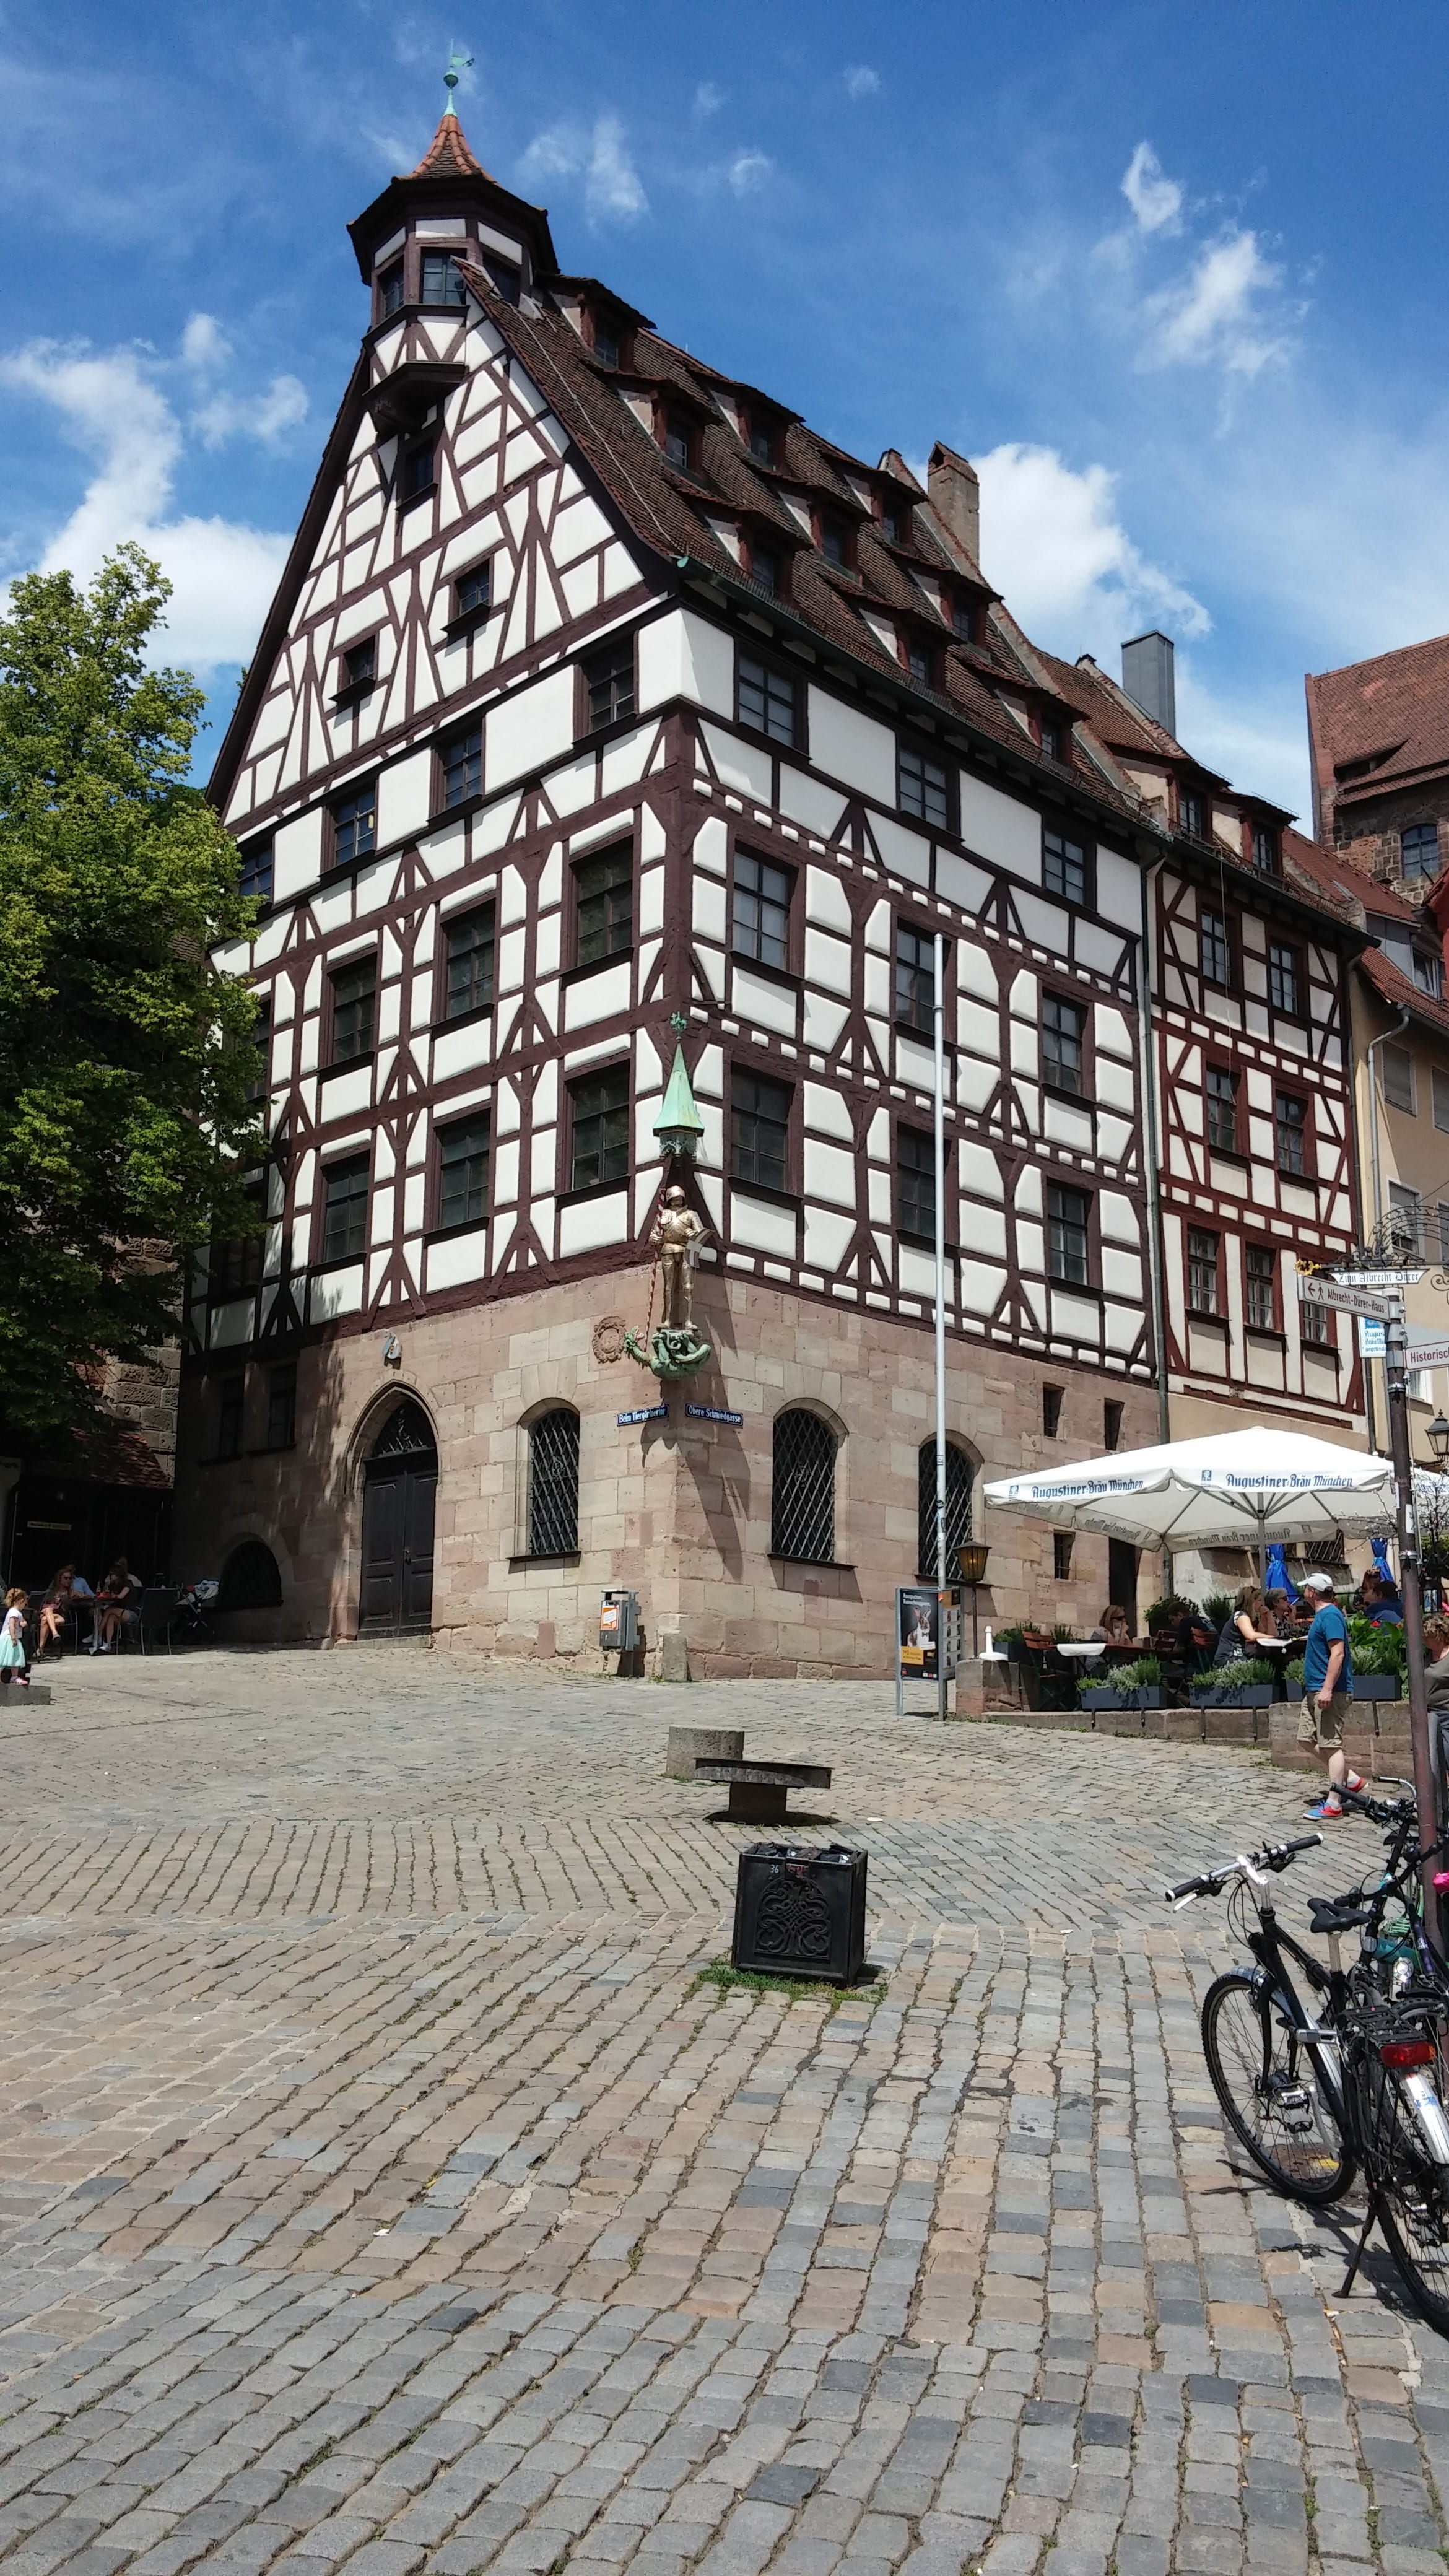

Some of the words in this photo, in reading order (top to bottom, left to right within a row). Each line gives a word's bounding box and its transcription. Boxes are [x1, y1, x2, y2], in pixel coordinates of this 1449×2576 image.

[1359, 1272, 1393, 1283] Albrecht
[1395, 1271, 1420, 1282] Dürer
[1327, 1288, 1385, 1313] Albrecht-Dürer-Haus
[1410, 1347, 1449, 1364] Historisc
[619, 1414, 632, 1424] Beim
[689, 1406, 705, 1416] Obere
[705, 1409, 741, 1422] Schmiedgasse
[1108, 1478, 1144, 1491] München
[1313, 1474, 1354, 1487] München
[770, 1864, 779, 1873] 36
